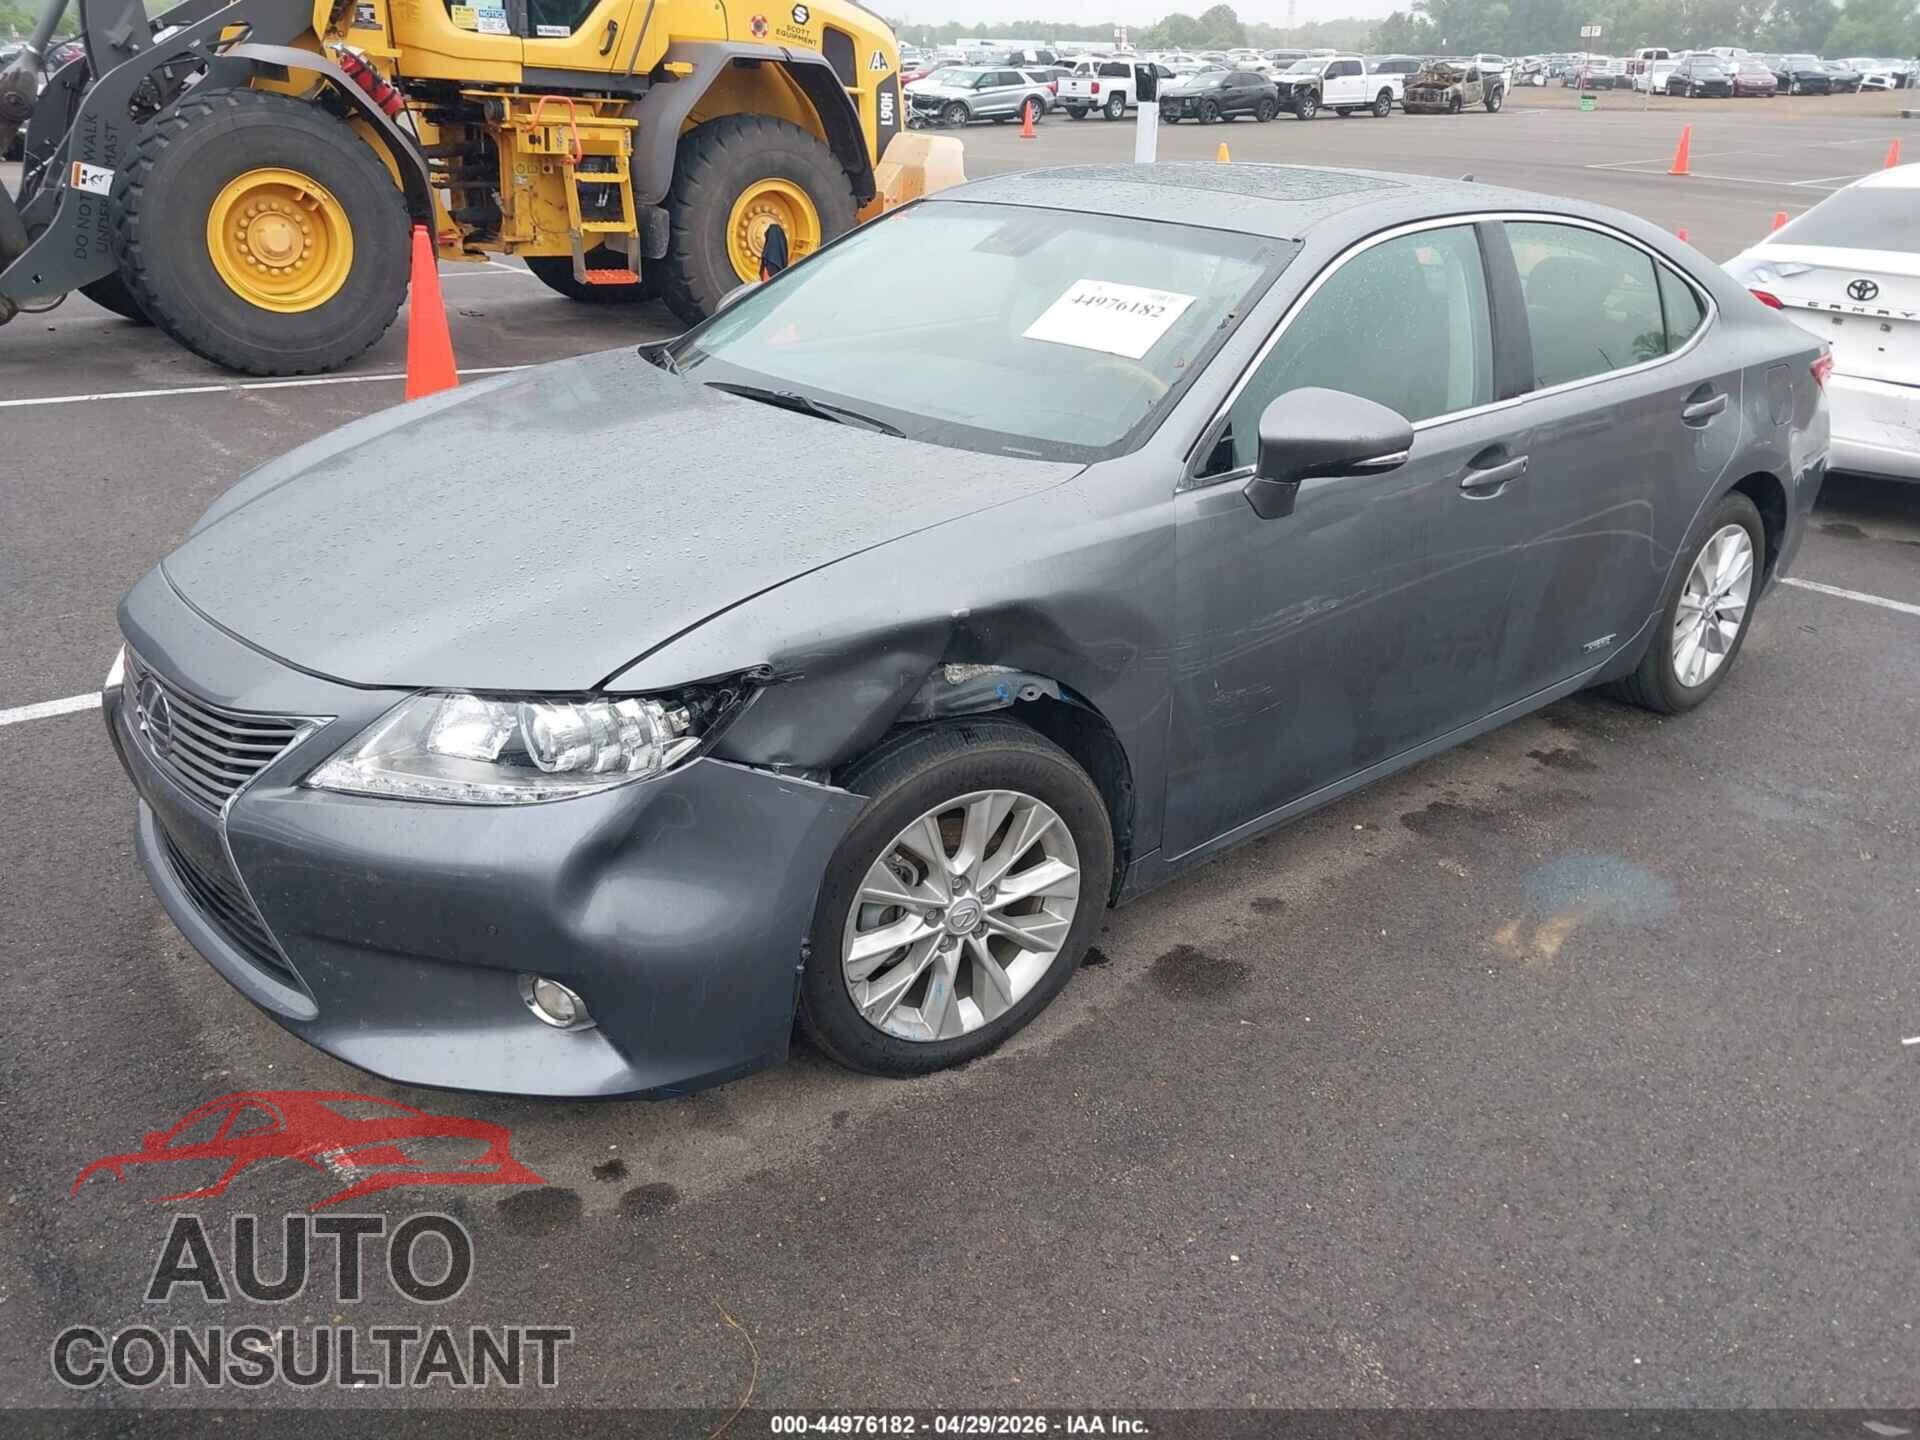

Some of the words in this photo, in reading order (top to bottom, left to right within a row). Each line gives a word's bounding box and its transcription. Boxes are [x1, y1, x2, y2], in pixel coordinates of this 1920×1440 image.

[775, 28, 818, 48] EQUIPMENT
[786, 24, 811, 37] SCOTT
[880, 92, 894, 126] L90H
[104, 120, 119, 168] MAST
[74, 234, 88, 260] DO
[81, 112, 97, 161] WALK
[1071, 294, 1166, 317] 44976182
[1807, 301, 1917, 317] CAMRY
